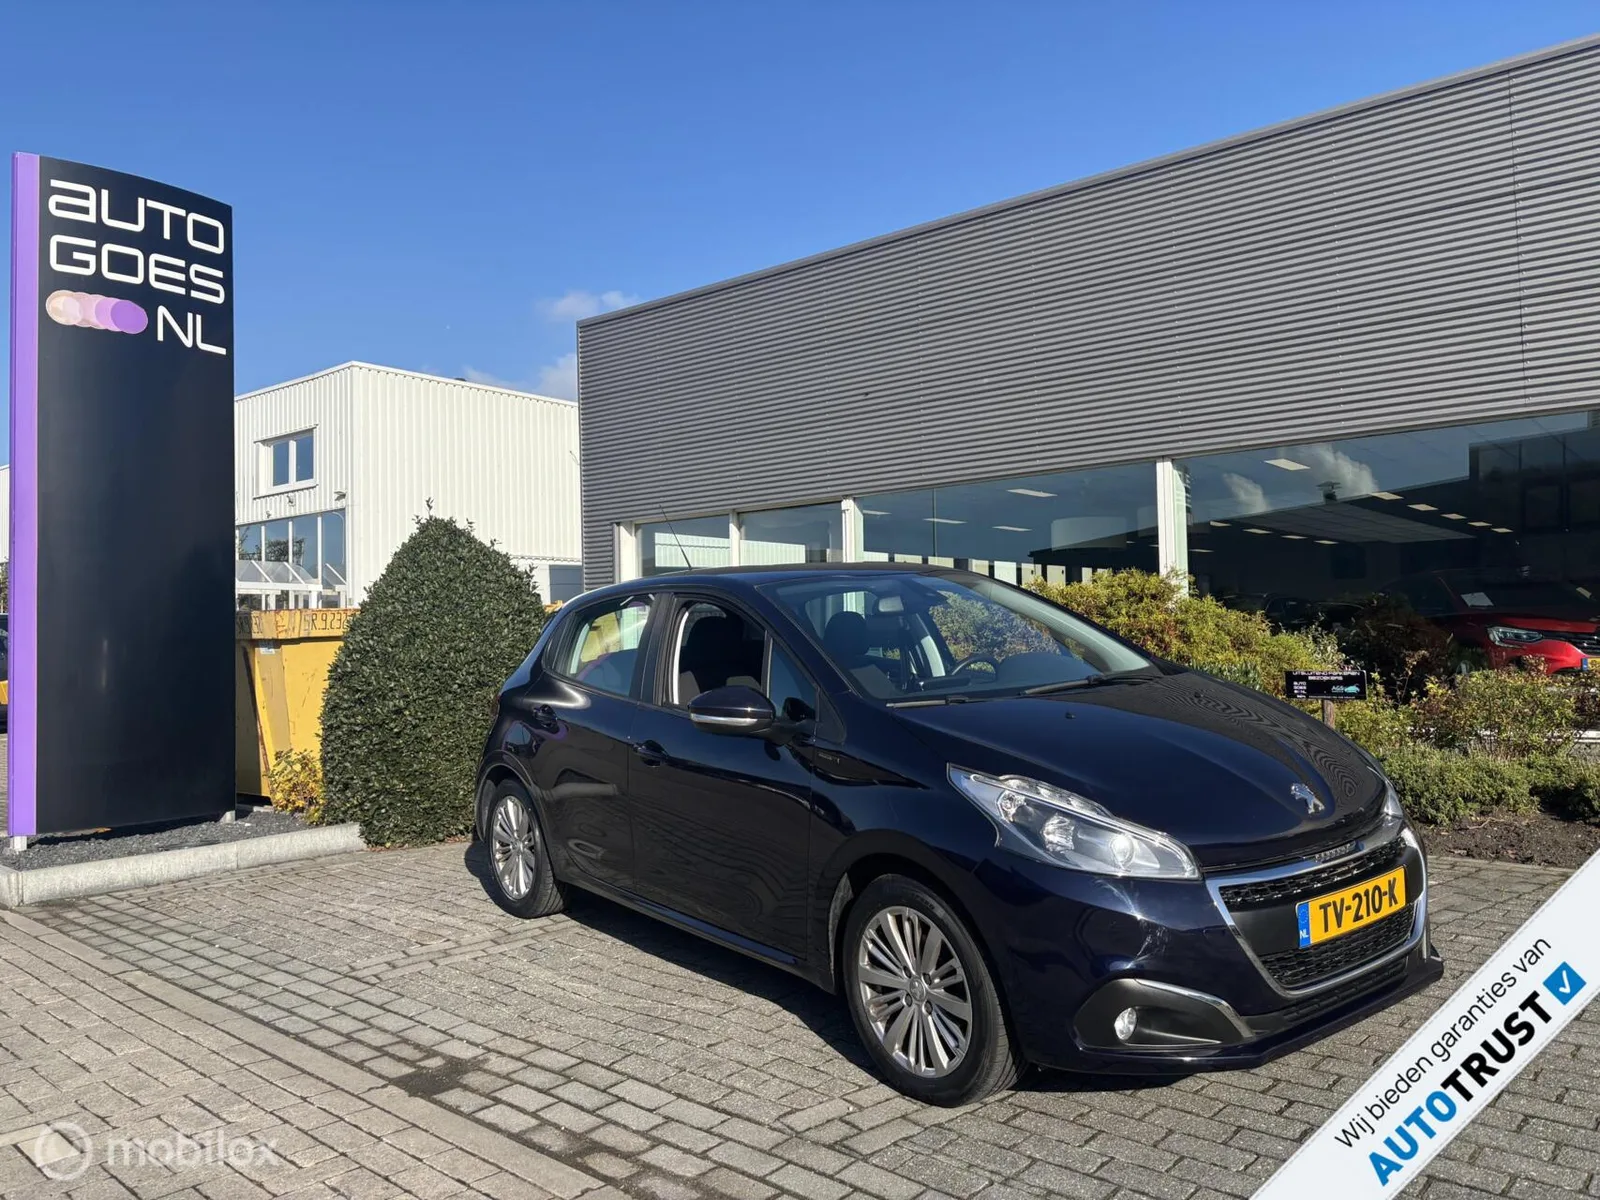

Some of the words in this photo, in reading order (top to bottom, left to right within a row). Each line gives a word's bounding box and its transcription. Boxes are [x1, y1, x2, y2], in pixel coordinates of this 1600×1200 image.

[49, 234, 225, 304] GOES
[157, 305, 227, 355] NL
[1319, 877, 1399, 933] TV-210-K
[1300, 929, 1309, 939] NL
